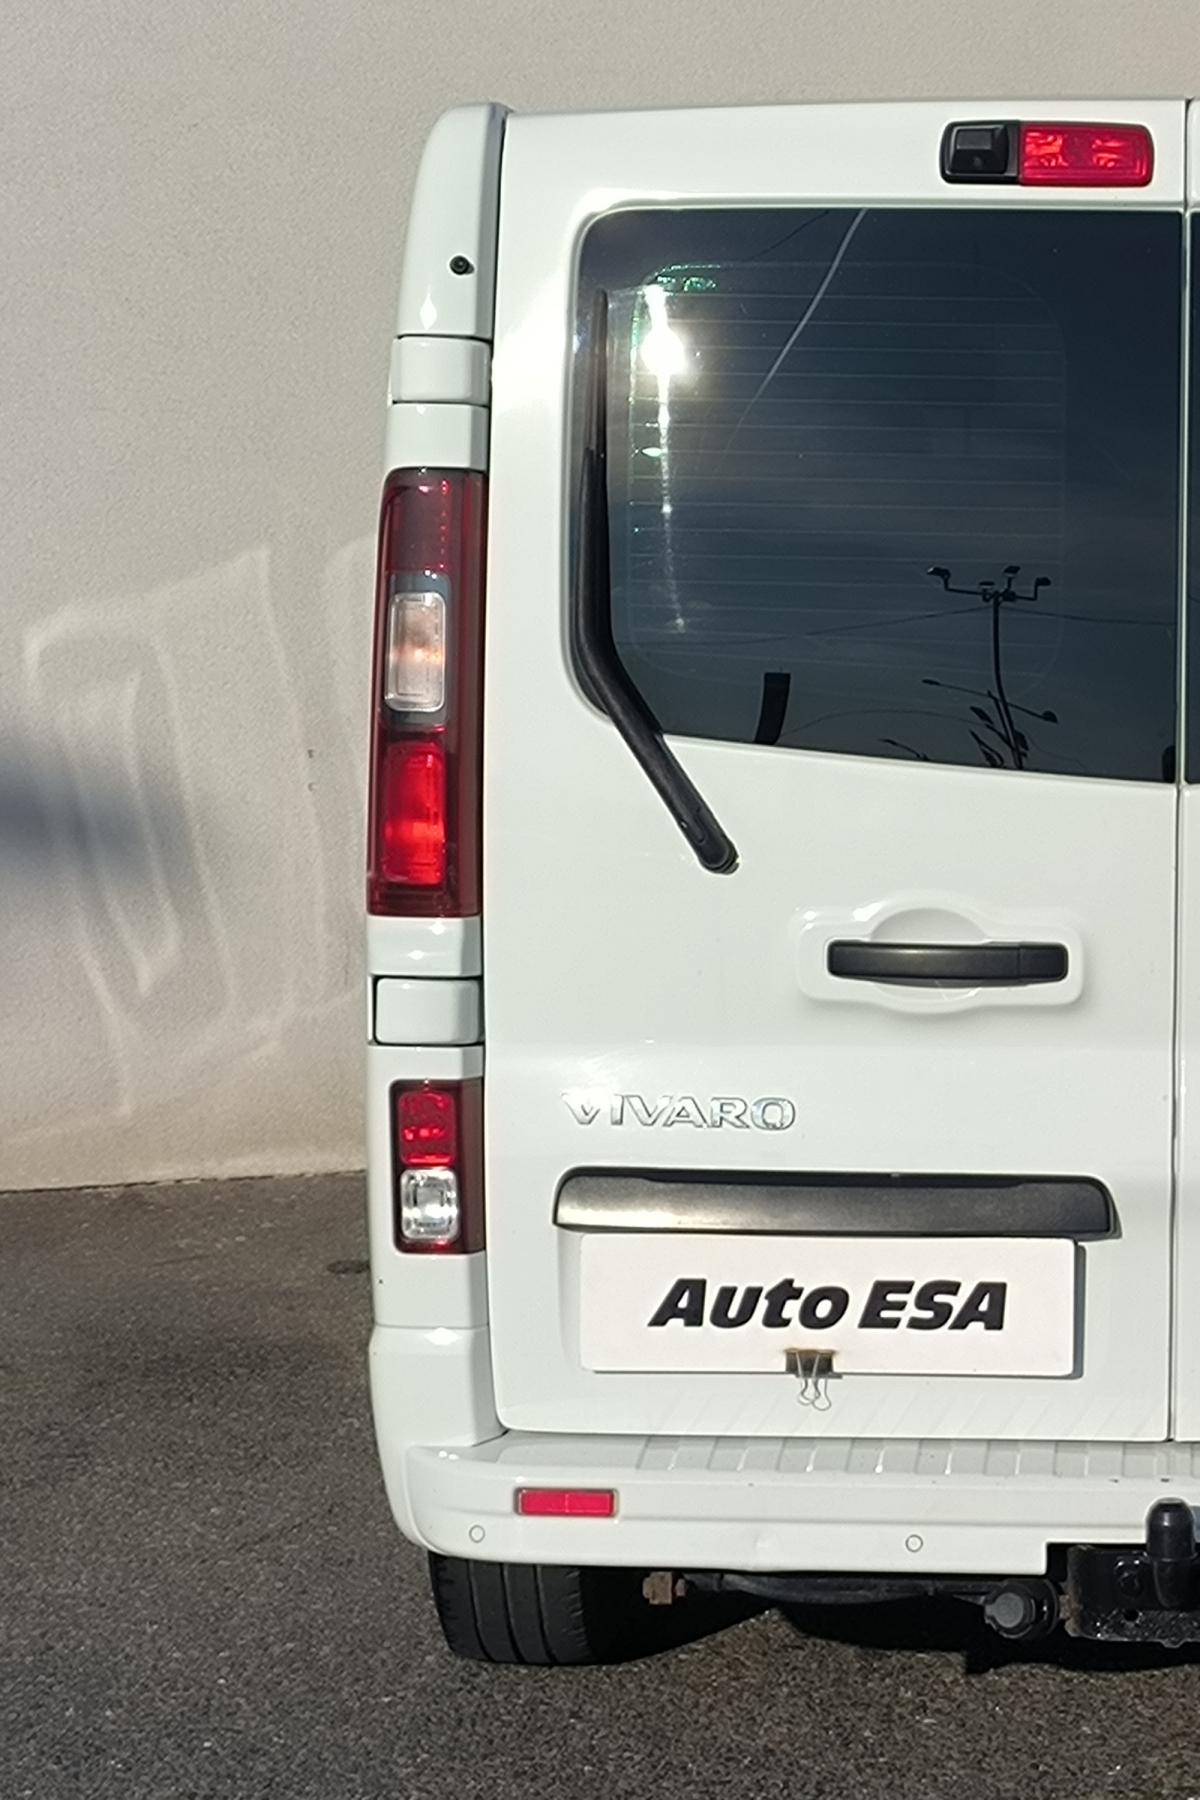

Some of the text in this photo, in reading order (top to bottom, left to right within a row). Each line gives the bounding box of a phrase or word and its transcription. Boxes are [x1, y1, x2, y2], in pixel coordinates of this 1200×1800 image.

[561, 1092, 796, 1130] VIVARO
[647, 1278, 1007, 1331] Auto ESA
